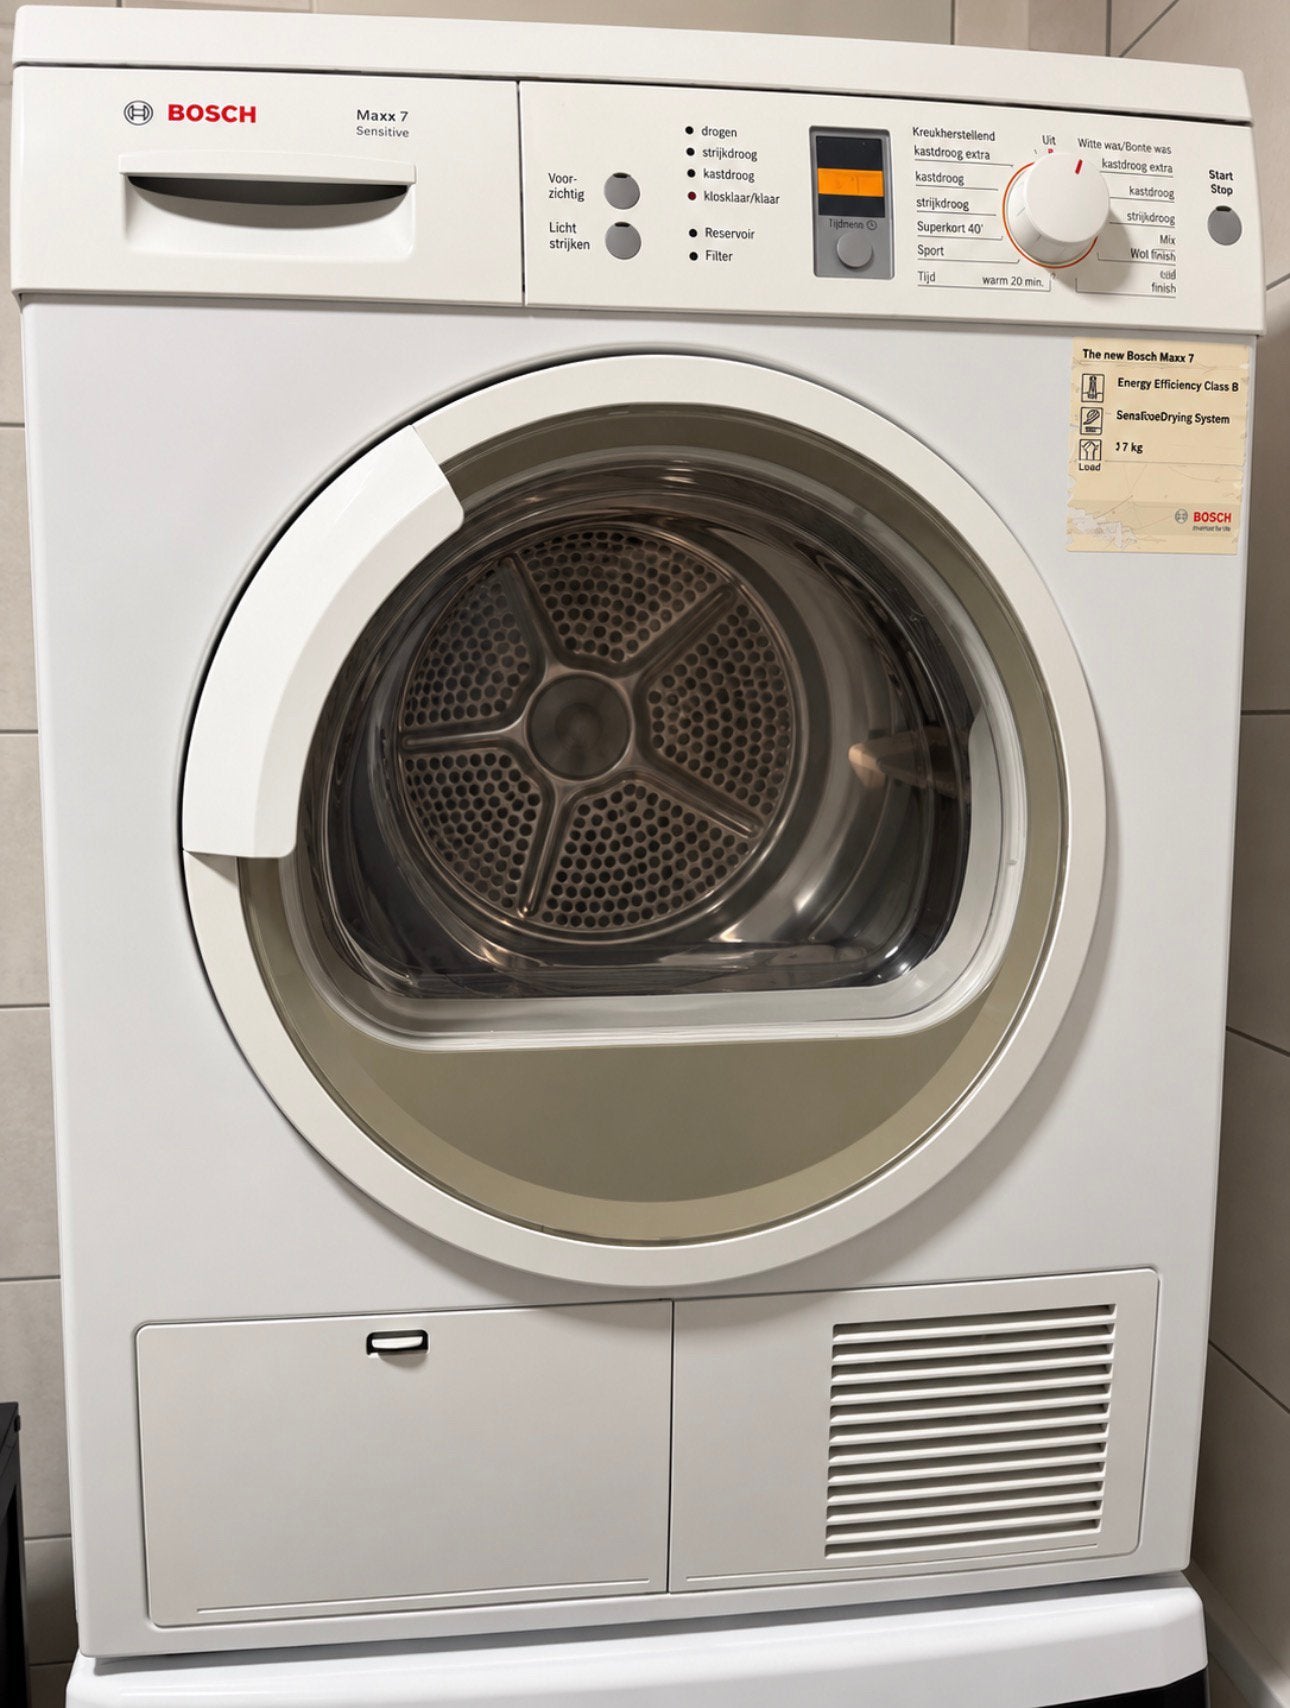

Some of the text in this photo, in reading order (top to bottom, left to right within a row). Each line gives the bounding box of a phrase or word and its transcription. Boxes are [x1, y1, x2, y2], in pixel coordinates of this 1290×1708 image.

[168, 104, 256, 123] BOSCH
[356, 109, 409, 123] Maxx 7
[356, 126, 410, 138] Sensitive
[701, 126, 738, 139] drogen
[912, 126, 996, 142] Kreukherstellend
[1042, 134, 1056, 146] Uit
[1077, 138, 1103, 149] Witte
[1154, 145, 1173, 155] was
[702, 147, 758, 162] strijkdroog
[914, 145, 991, 160] kastdroog extra
[1101, 158, 1174, 174] kastdroog extra
[548, 172, 578, 184] Voor-
[703, 168, 755, 183] kastdroog
[915, 170, 965, 186] kastdroog
[1208, 169, 1235, 181] Start
[548, 187, 585, 202] zichtig
[703, 191, 780, 204] klosklaar/klaar
[1129, 185, 1175, 200] kastdroog
[1210, 184, 1234, 197] Stop
[916, 197, 970, 211] strijkdroog
[1126, 211, 1176, 226] strijkdroog
[549, 222, 577, 234] Licht
[705, 227, 755, 240] Reservoir
[917, 220, 966, 235] Superkort
[549, 237, 591, 251] strijken
[1159, 234, 1177, 246] Mix
[705, 249, 733, 262] Filter
[917, 243, 945, 257] Sport
[1130, 248, 1177, 262] Wol finish
[917, 270, 936, 283] Tijd
[982, 275, 1045, 288] warm 20 min.
[1151, 282, 1177, 294] finish
[1083, 349, 1195, 364] The new Bosch Maxx 7
[1117, 377, 1239, 393] Energy Efficiency Class B
[1194, 413, 1230, 426] System
[1130, 442, 1143, 454] kg
[1079, 463, 1101, 472] Load
[1193, 512, 1232, 523] BOSCH
